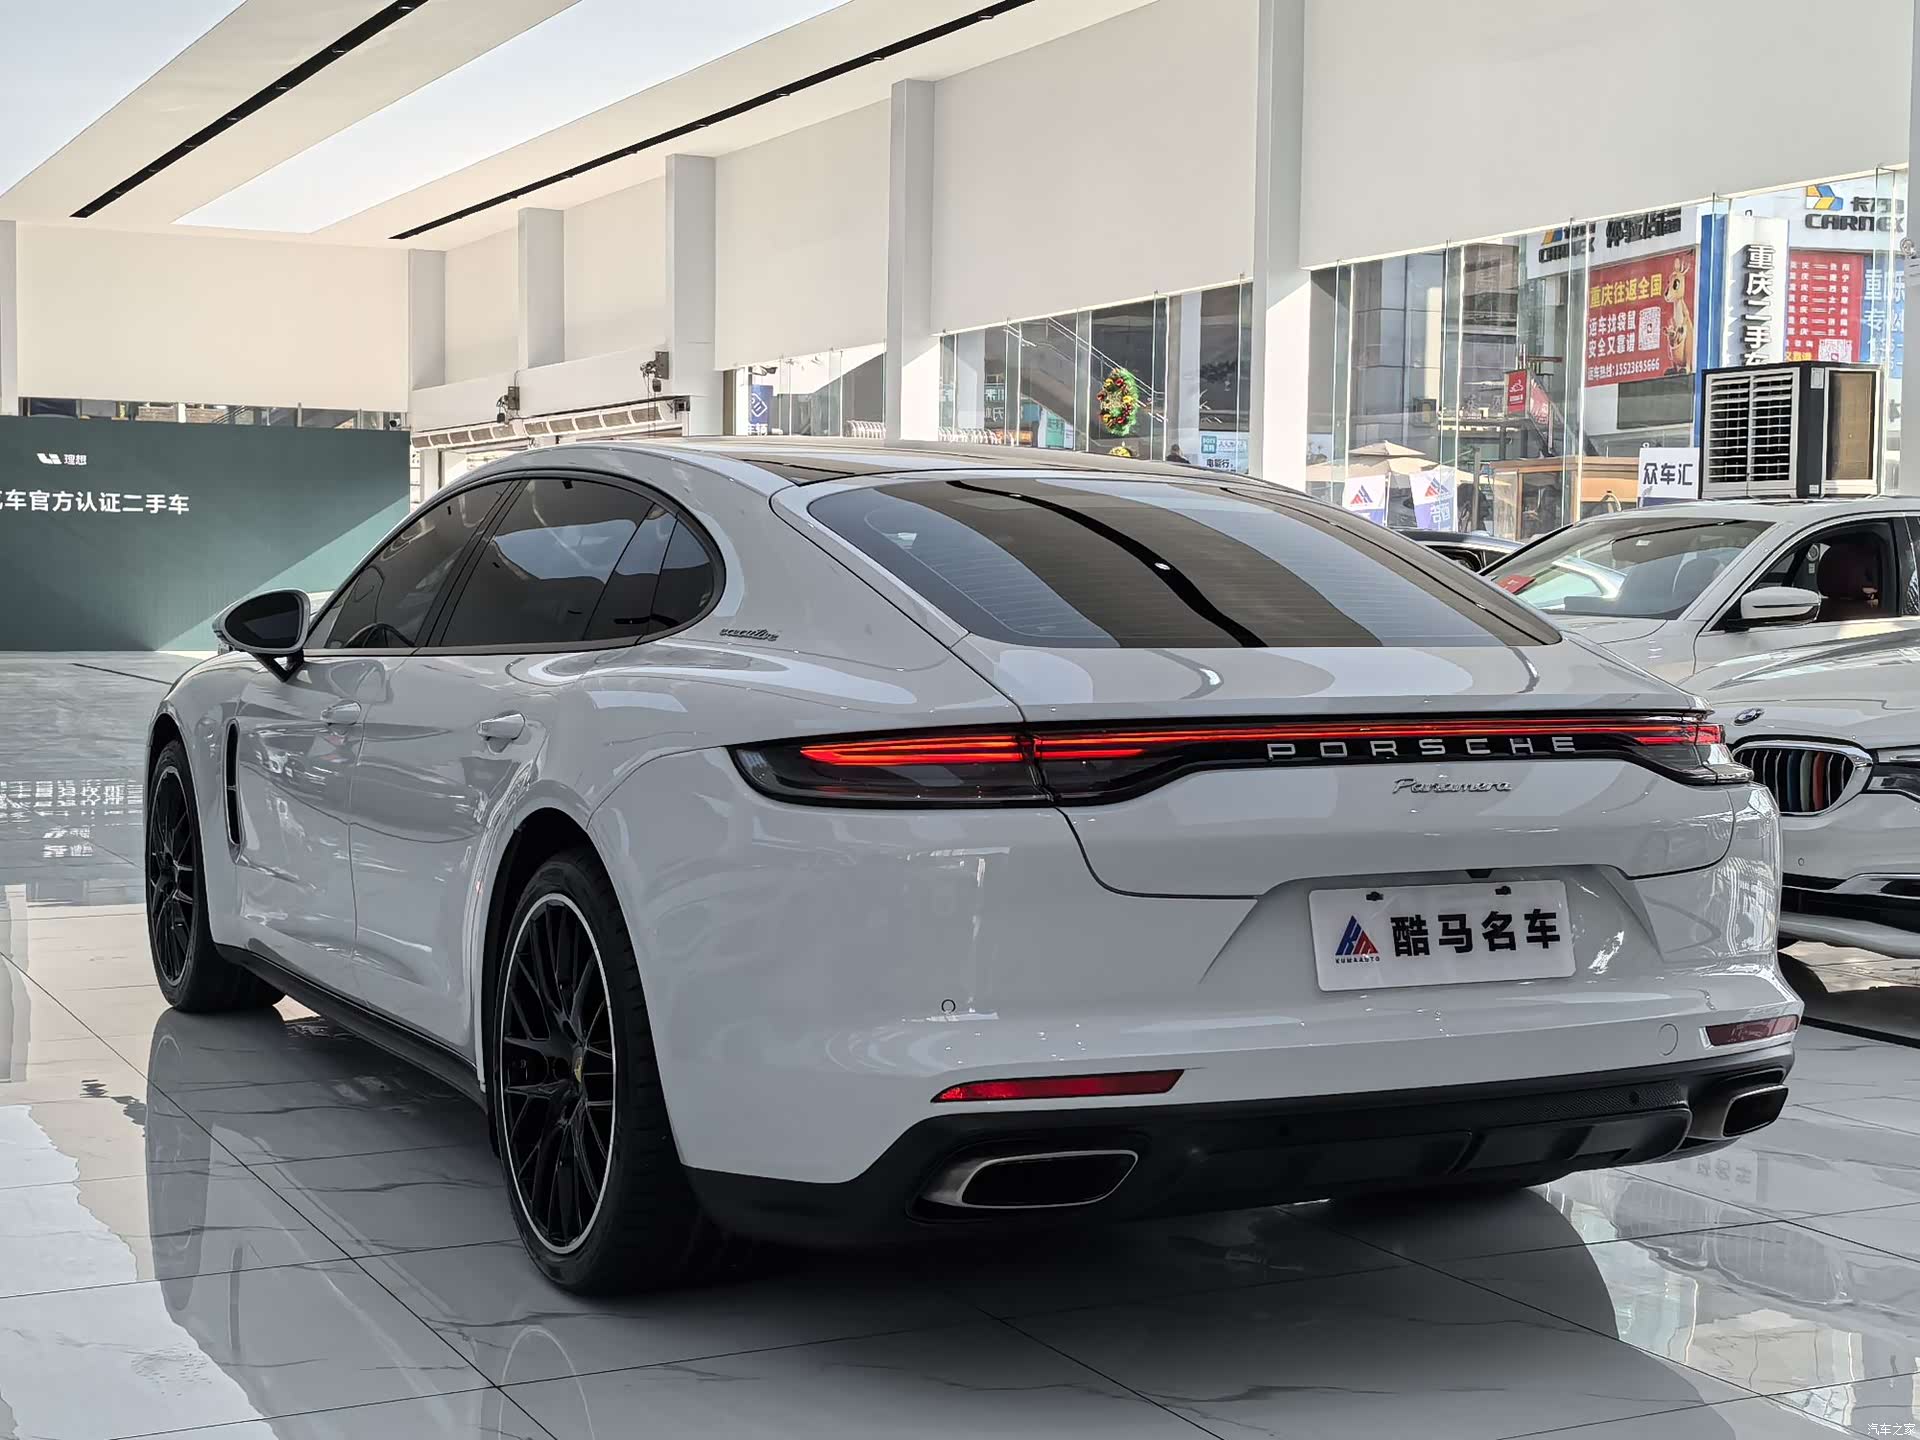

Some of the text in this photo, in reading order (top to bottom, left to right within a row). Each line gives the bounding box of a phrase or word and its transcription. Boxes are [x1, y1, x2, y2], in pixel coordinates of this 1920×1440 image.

[1590, 273, 1662, 308] 重庆往返全国
[1588, 333, 1636, 359] 安全又靠谱
[64, 454, 87, 465] 理想
[1642, 462, 1694, 486] 众车汇
[0, 488, 190, 515] 车官方认证二手车
[1266, 736, 1576, 761] PORSCHE
[1392, 777, 1513, 795] Panamera
[1390, 908, 1561, 957] 酷马名车
